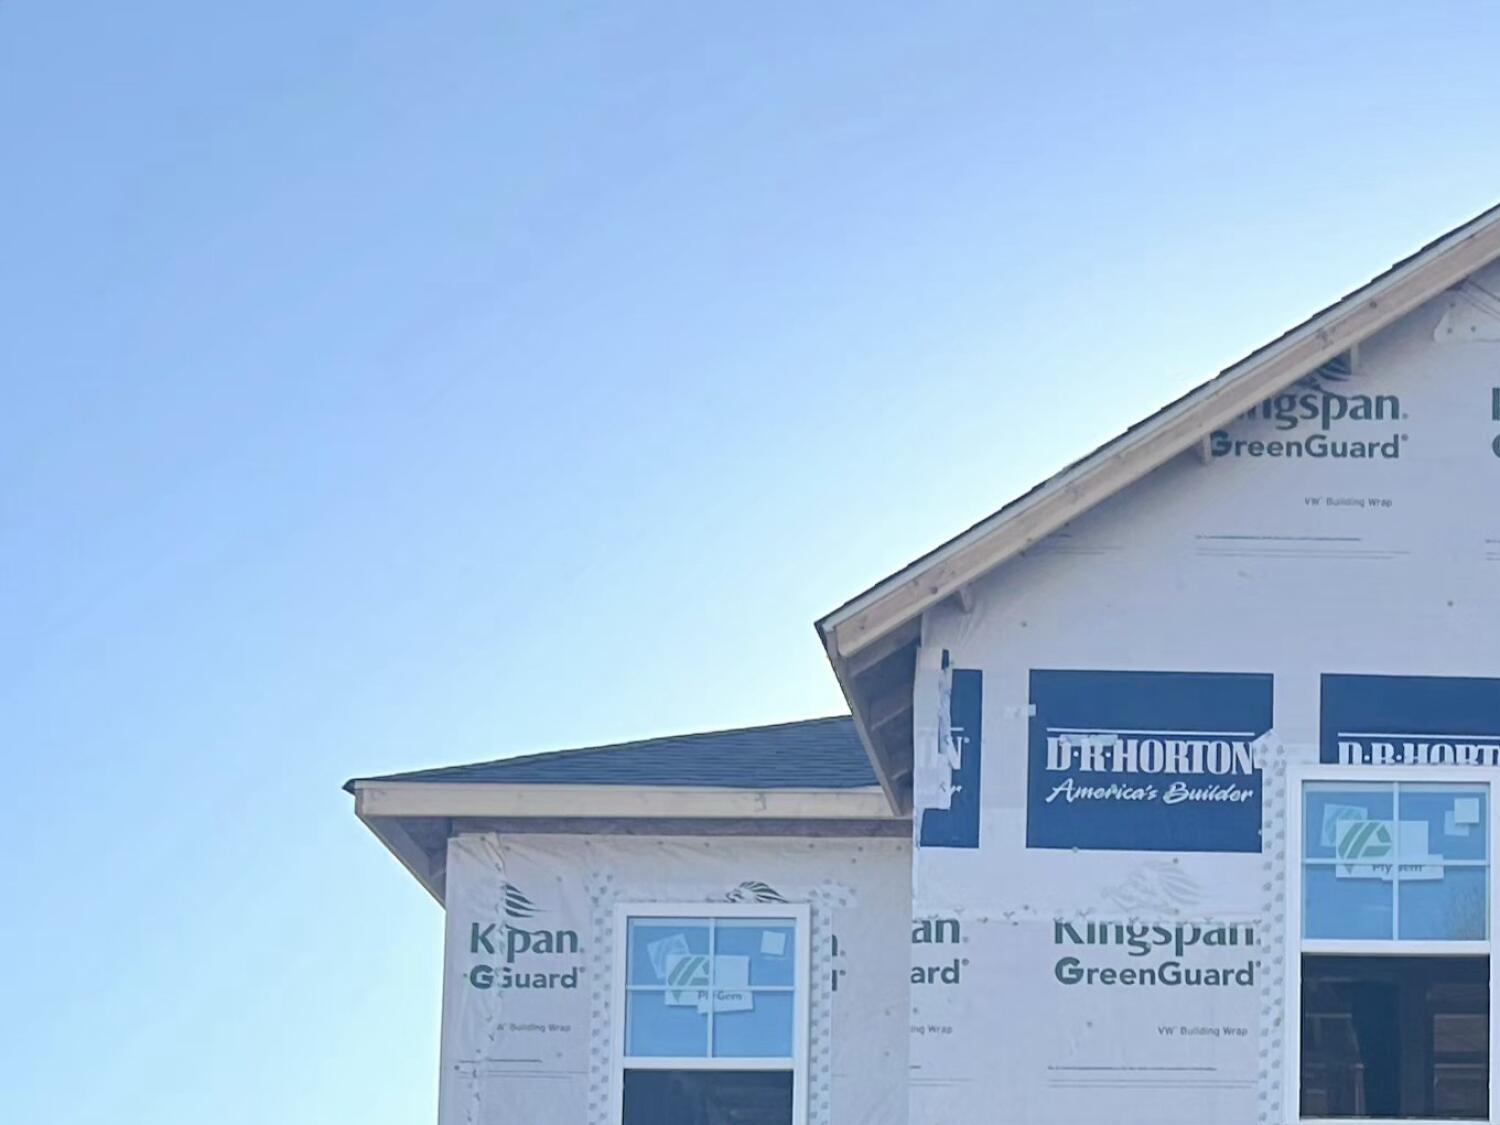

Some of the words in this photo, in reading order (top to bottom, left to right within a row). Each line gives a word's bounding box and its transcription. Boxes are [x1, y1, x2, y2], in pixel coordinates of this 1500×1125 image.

[1248, 391, 1399, 430] ngspan
[1210, 431, 1399, 459] GreenGuard
[1338, 741, 1500, 766] D·R·HORT
[1046, 778, 1157, 803] America's
[1163, 782, 1253, 804] Builder
[471, 922, 578, 963] Kpan
[1054, 920, 1254, 957] Kingspan
[1055, 956, 1254, 986] GreenGuard
[1180, 1026, 1220, 1037] Building
[1223, 1026, 1248, 1037] Wrap
